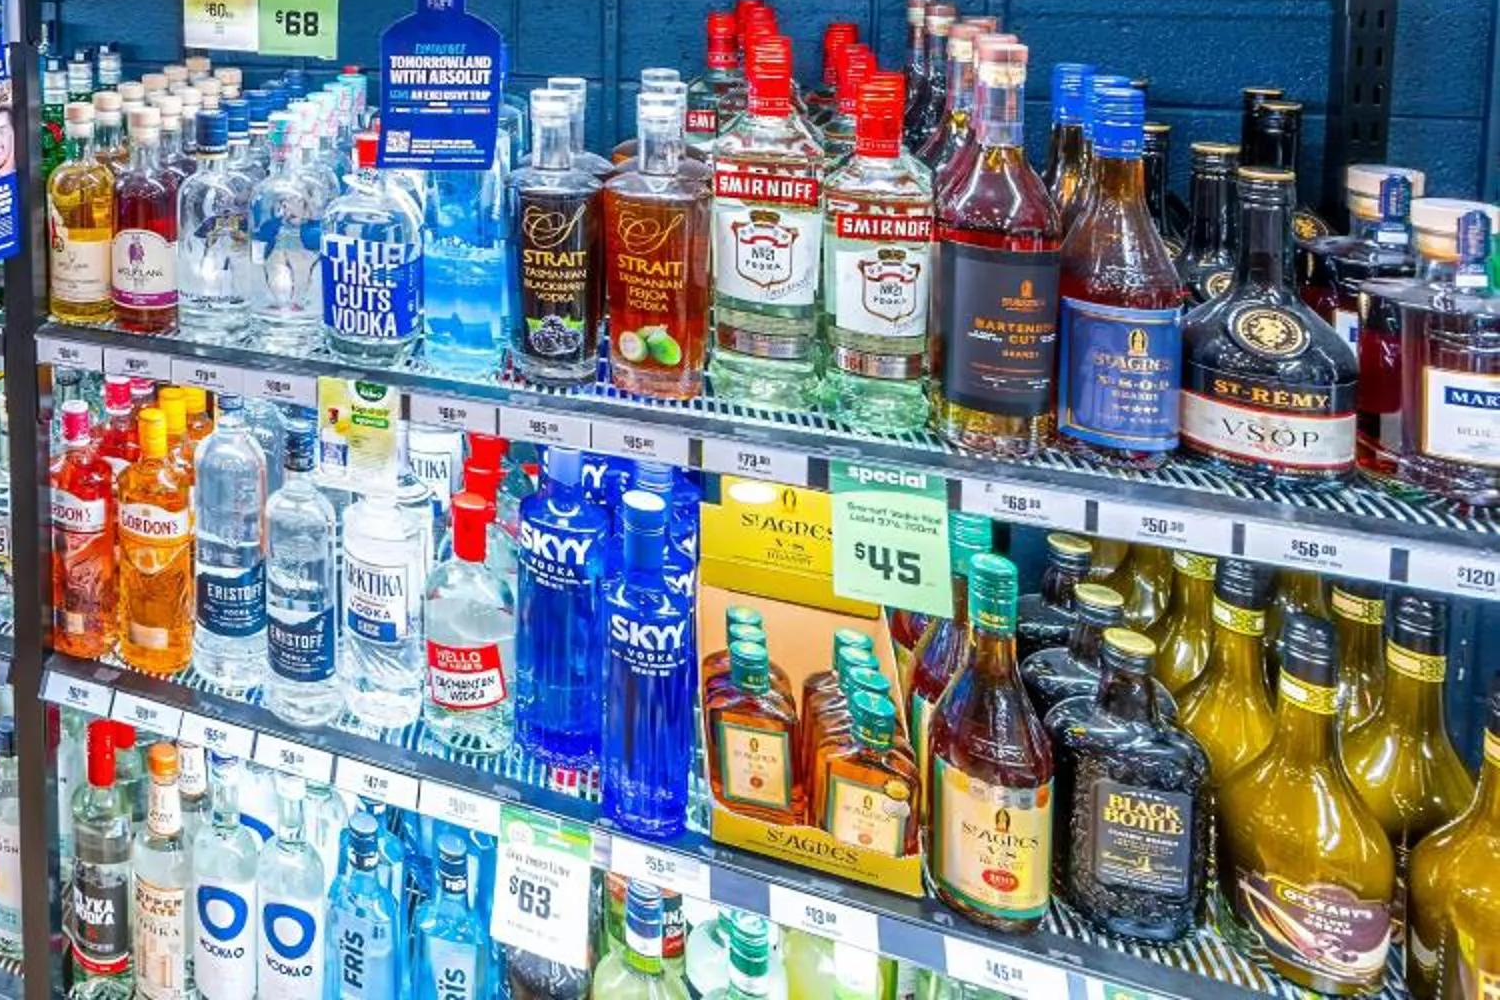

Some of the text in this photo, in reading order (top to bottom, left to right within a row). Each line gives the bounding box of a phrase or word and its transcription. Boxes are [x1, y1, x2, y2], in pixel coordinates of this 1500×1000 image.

[275, 10, 319, 37] $68
[389, 55, 493, 69] TOMORROWLAND
[389, 69, 493, 85] WITH ABSOLUT
[718, 174, 814, 200] SMIRNOFF
[841, 219, 932, 239] SMIRNOFF
[522, 249, 587, 268] STRAIT
[617, 255, 683, 277] STRAIT
[332, 257, 398, 288] THREE
[524, 266, 587, 280] TASMANIAN
[618, 274, 684, 288] TASMANIAN
[335, 285, 392, 313] CUTS
[332, 311, 398, 338] VODKA
[1220, 416, 1320, 450] VSOP
[848, 465, 928, 490] special
[121, 508, 179, 536] GORDON'S
[520, 520, 594, 566] SKYY
[529, 555, 576, 579] VODKA
[855, 541, 922, 586] $45
[207, 581, 264, 601] ERISTOFF
[270, 623, 324, 650] ERISTOFF
[610, 613, 687, 651] SKYY
[626, 648, 674, 664] VODKA
[1108, 792, 1182, 822] BLACK
[1103, 807, 1184, 835] BOTTLE
[509, 875, 552, 921] $63
